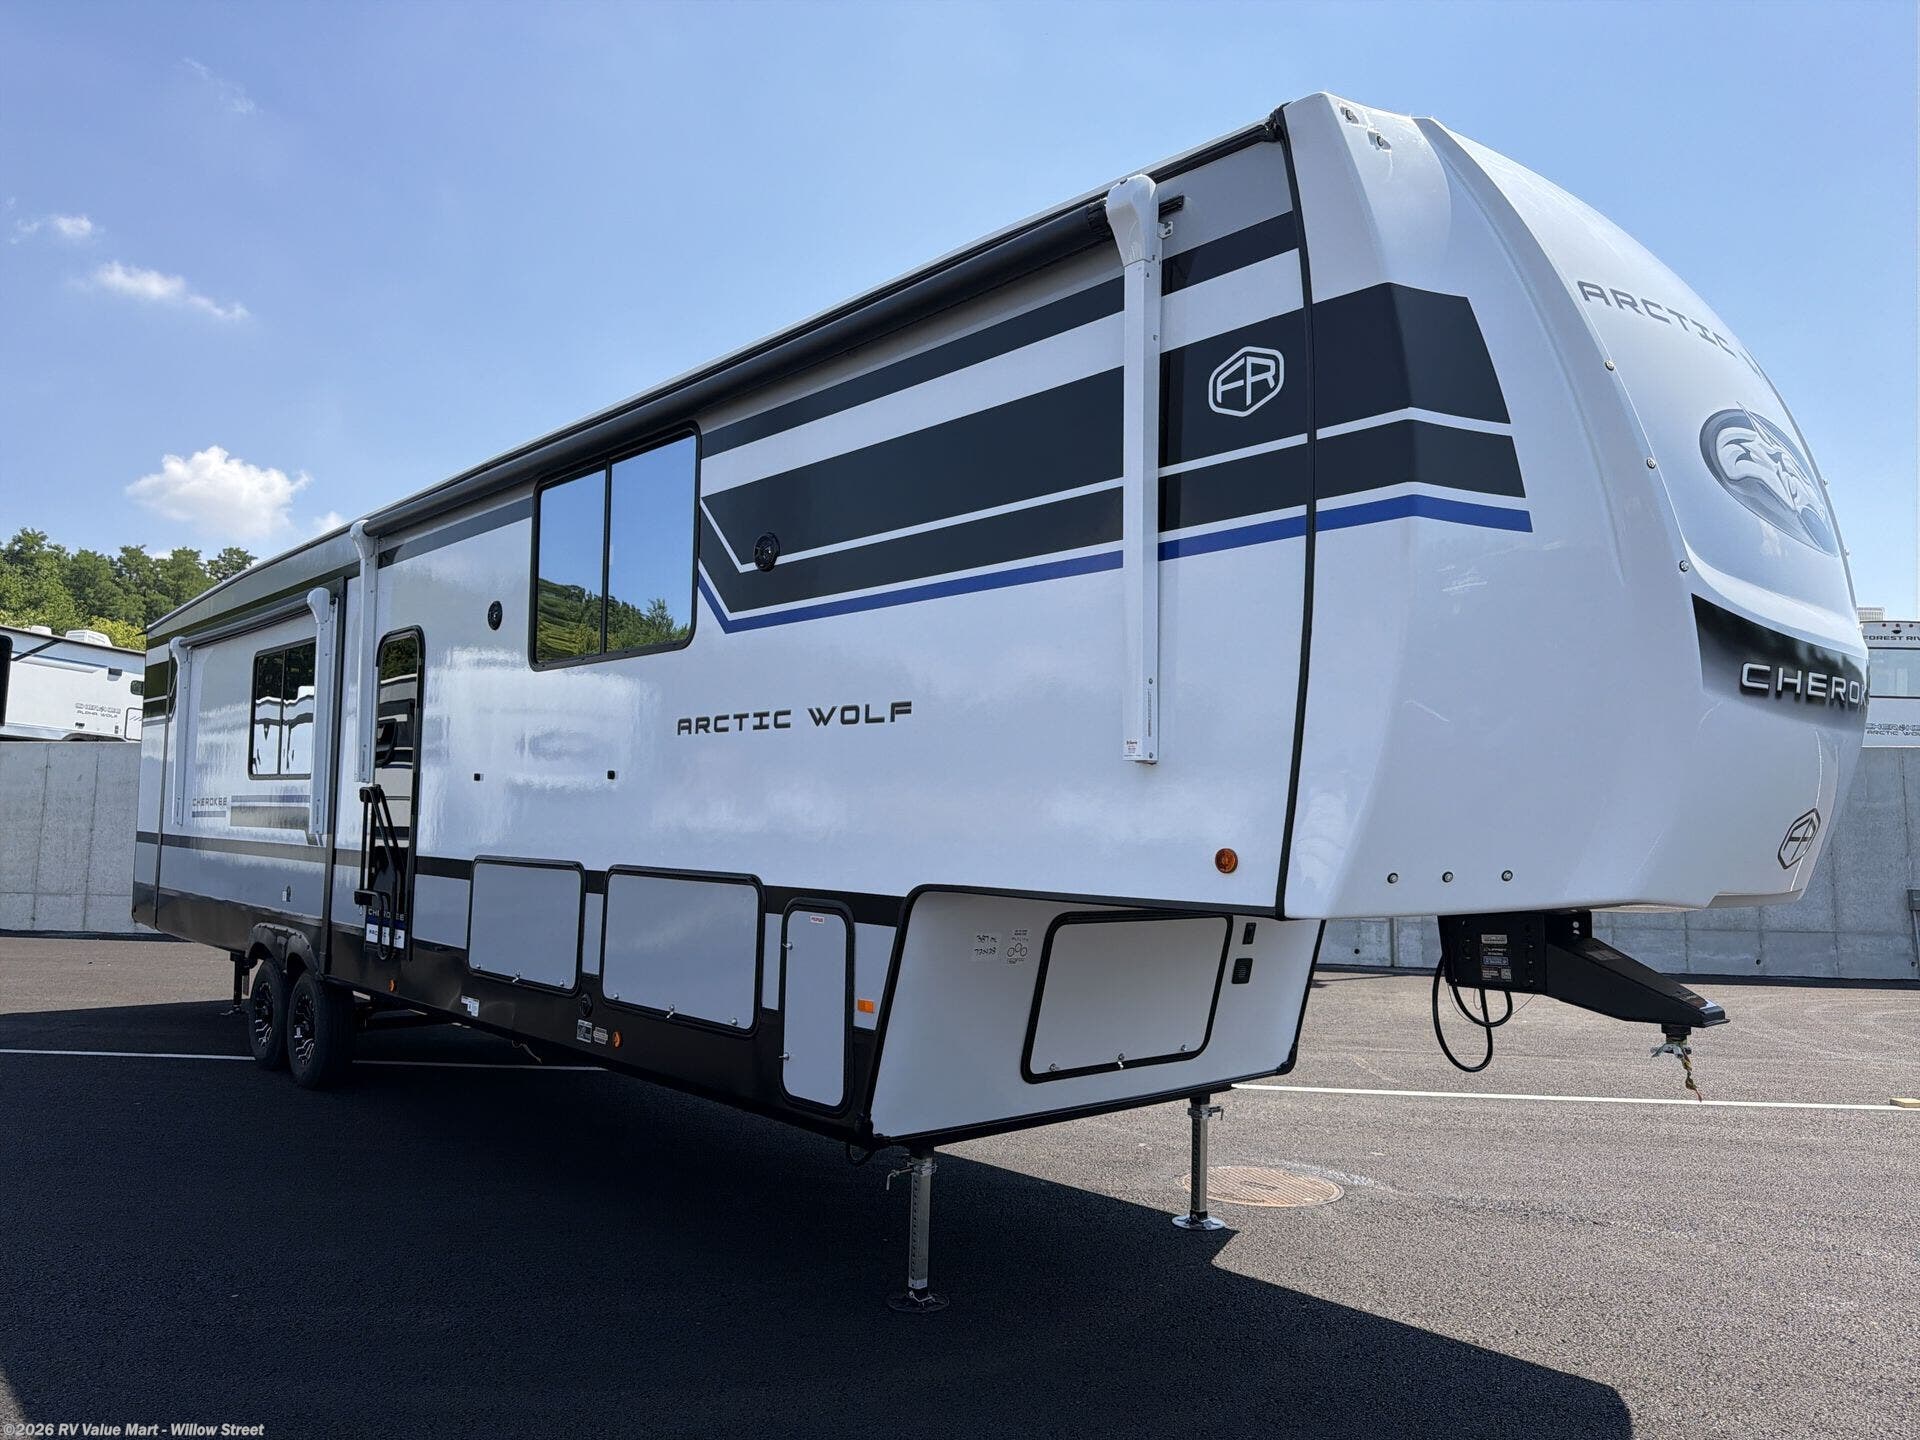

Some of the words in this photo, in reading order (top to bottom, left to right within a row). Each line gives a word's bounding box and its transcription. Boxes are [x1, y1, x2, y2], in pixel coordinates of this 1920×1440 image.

[1577, 280, 1738, 359] ARCTIC
[676, 709, 792, 736] ARCTIC
[807, 701, 913, 727] WOLF
[192, 797, 228, 807] CHEROKEE
